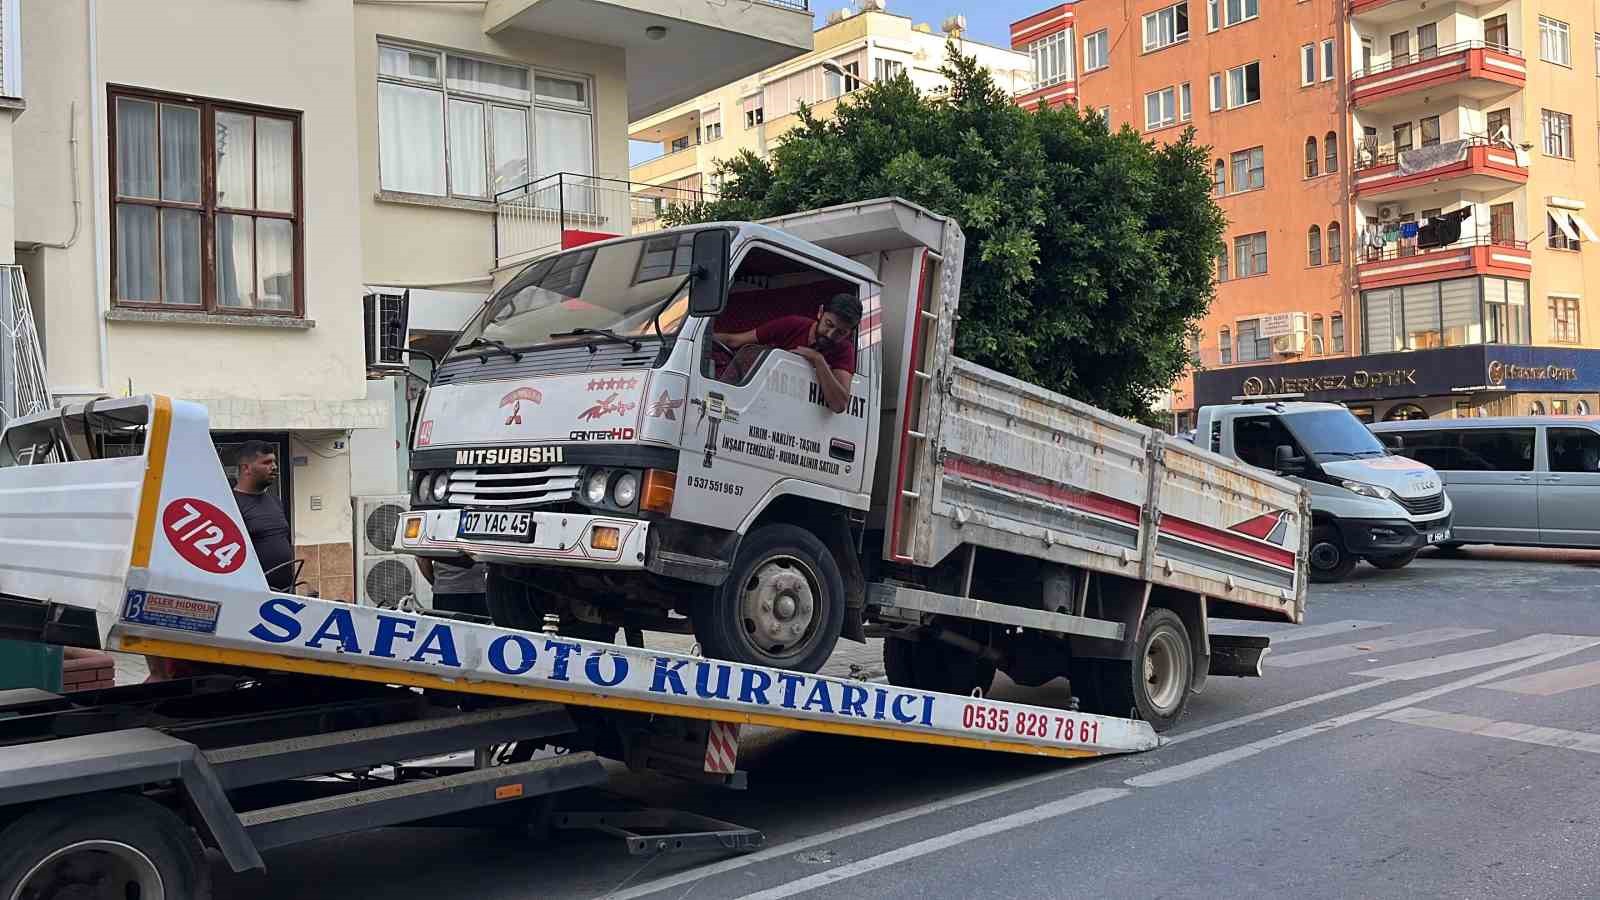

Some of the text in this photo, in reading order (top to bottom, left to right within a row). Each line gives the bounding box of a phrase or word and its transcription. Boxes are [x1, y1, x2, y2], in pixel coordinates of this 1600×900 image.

[809, 381, 866, 419] HAYAT
[455, 446, 563, 465] MITSUBISHI
[721, 433, 746, 453] İNŞAAT
[170, 503, 241, 569] 7/24
[465, 513, 529, 533] 07 YAC 45
[248, 598, 936, 727] SAFA OTO KURTARICI
[963, 704, 1099, 744] 0535 828 78 61
